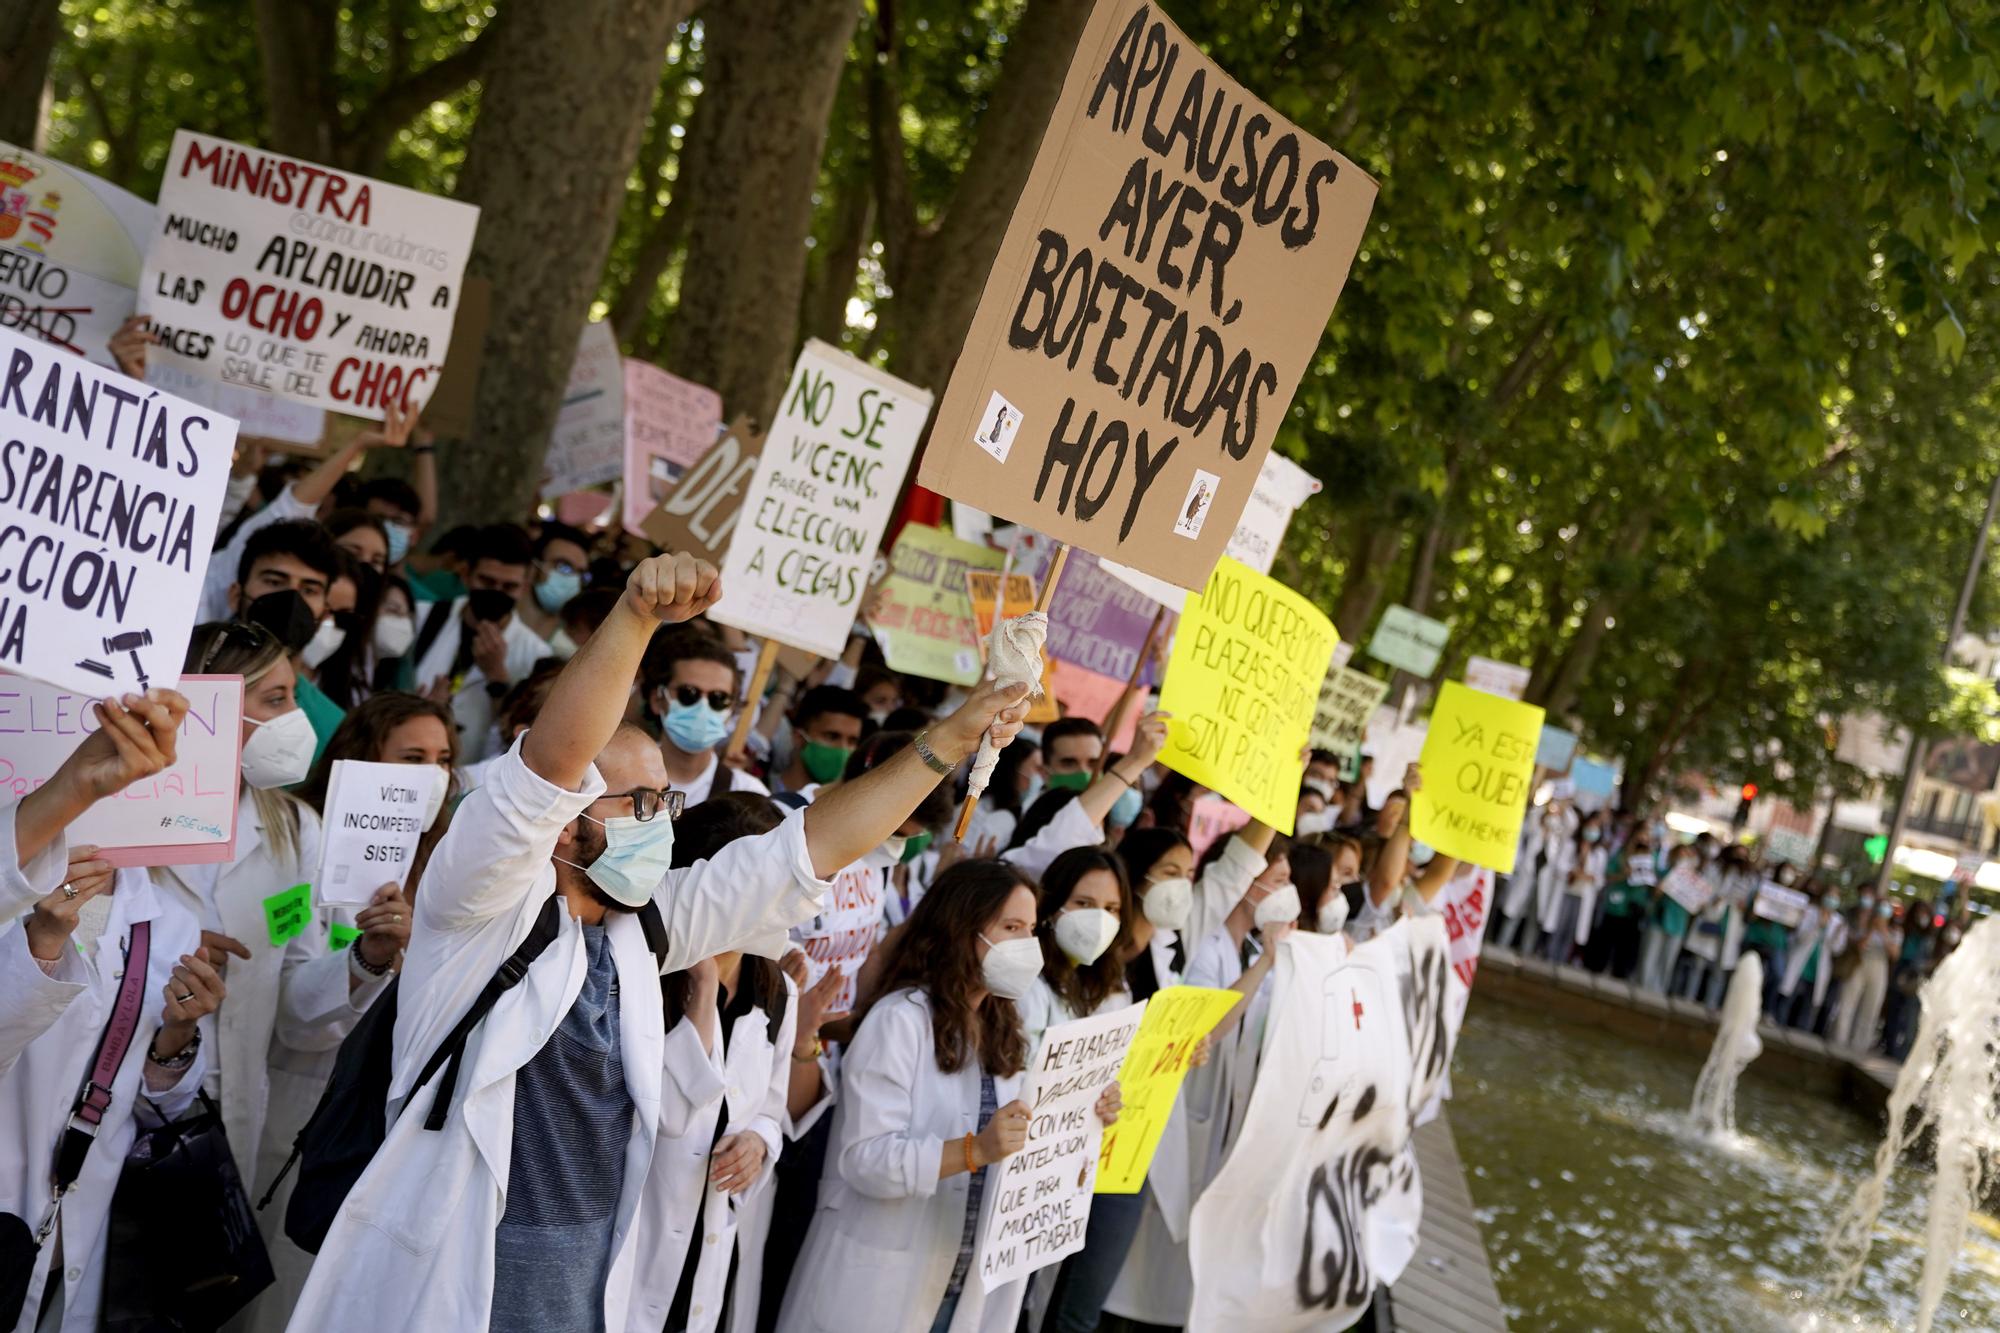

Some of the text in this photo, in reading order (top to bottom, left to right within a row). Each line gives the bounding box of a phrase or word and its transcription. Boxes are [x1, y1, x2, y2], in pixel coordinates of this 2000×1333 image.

[1087, 3, 1339, 252] APLAUSOS
[164, 214, 238, 253] MUCHO
[431, 286, 449, 309] A
[1099, 157, 1245, 325] AYER,
[0, 293, 77, 343] DAD
[157, 272, 430, 359] LAS OCHO Y AHORA
[224, 331, 252, 356] LO
[257, 340, 296, 368] QUE
[306, 351, 328, 374] TE
[1008, 228, 1278, 462] BOFETADAS
[221, 356, 276, 388] SALE
[284, 371, 319, 399] DEL
[788, 368, 834, 427] NO
[0, 348, 209, 478] RANTÍAS
[768, 471, 860, 513] PARECE UNA
[1033, 398, 1180, 545] HOY
[0, 440, 195, 573] SPARENCIA
[754, 496, 868, 554] ELECCION
[744, 545, 765, 578] A
[1191, 624, 1268, 692] PLAZAS
[1217, 685, 1245, 722] NI
[1174, 713, 1227, 768] SIN
[1451, 715, 1484, 749] YA
[1043, 1040, 1073, 1072] HE
[1028, 1112, 1058, 1141] CON
[1007, 1134, 1089, 1176] ANTELACION
[999, 1198, 1073, 1241] MUDARME
[1000, 1176, 1061, 1214] QUE PARA
[983, 1253, 993, 1277] A
[994, 1246, 1016, 1273] MI
